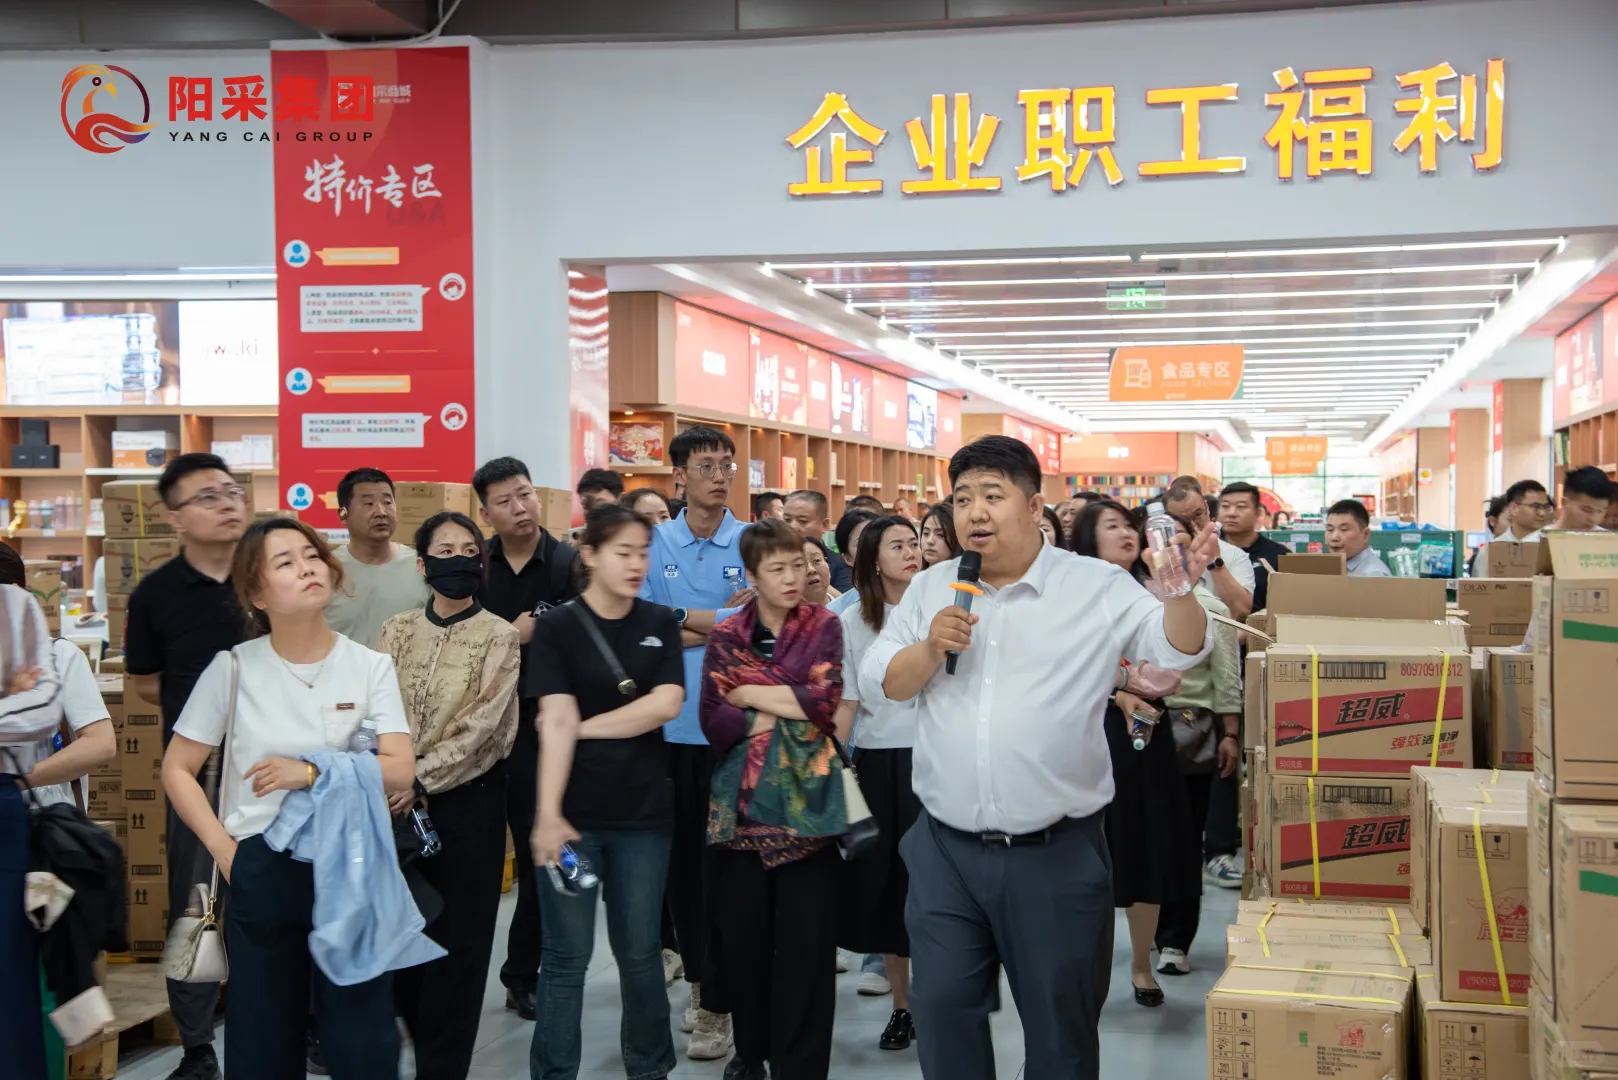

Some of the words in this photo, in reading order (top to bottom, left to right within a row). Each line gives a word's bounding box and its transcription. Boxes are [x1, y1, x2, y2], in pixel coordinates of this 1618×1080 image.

[785, 57, 1506, 198] 企业职工福利
[303, 153, 443, 217] 特价专区
[1160, 361, 1231, 379] 食品专区
[1463, 583, 1489, 593] OLAY
[1335, 692, 1407, 726] 超威
[1341, 817, 1411, 850] 超威
